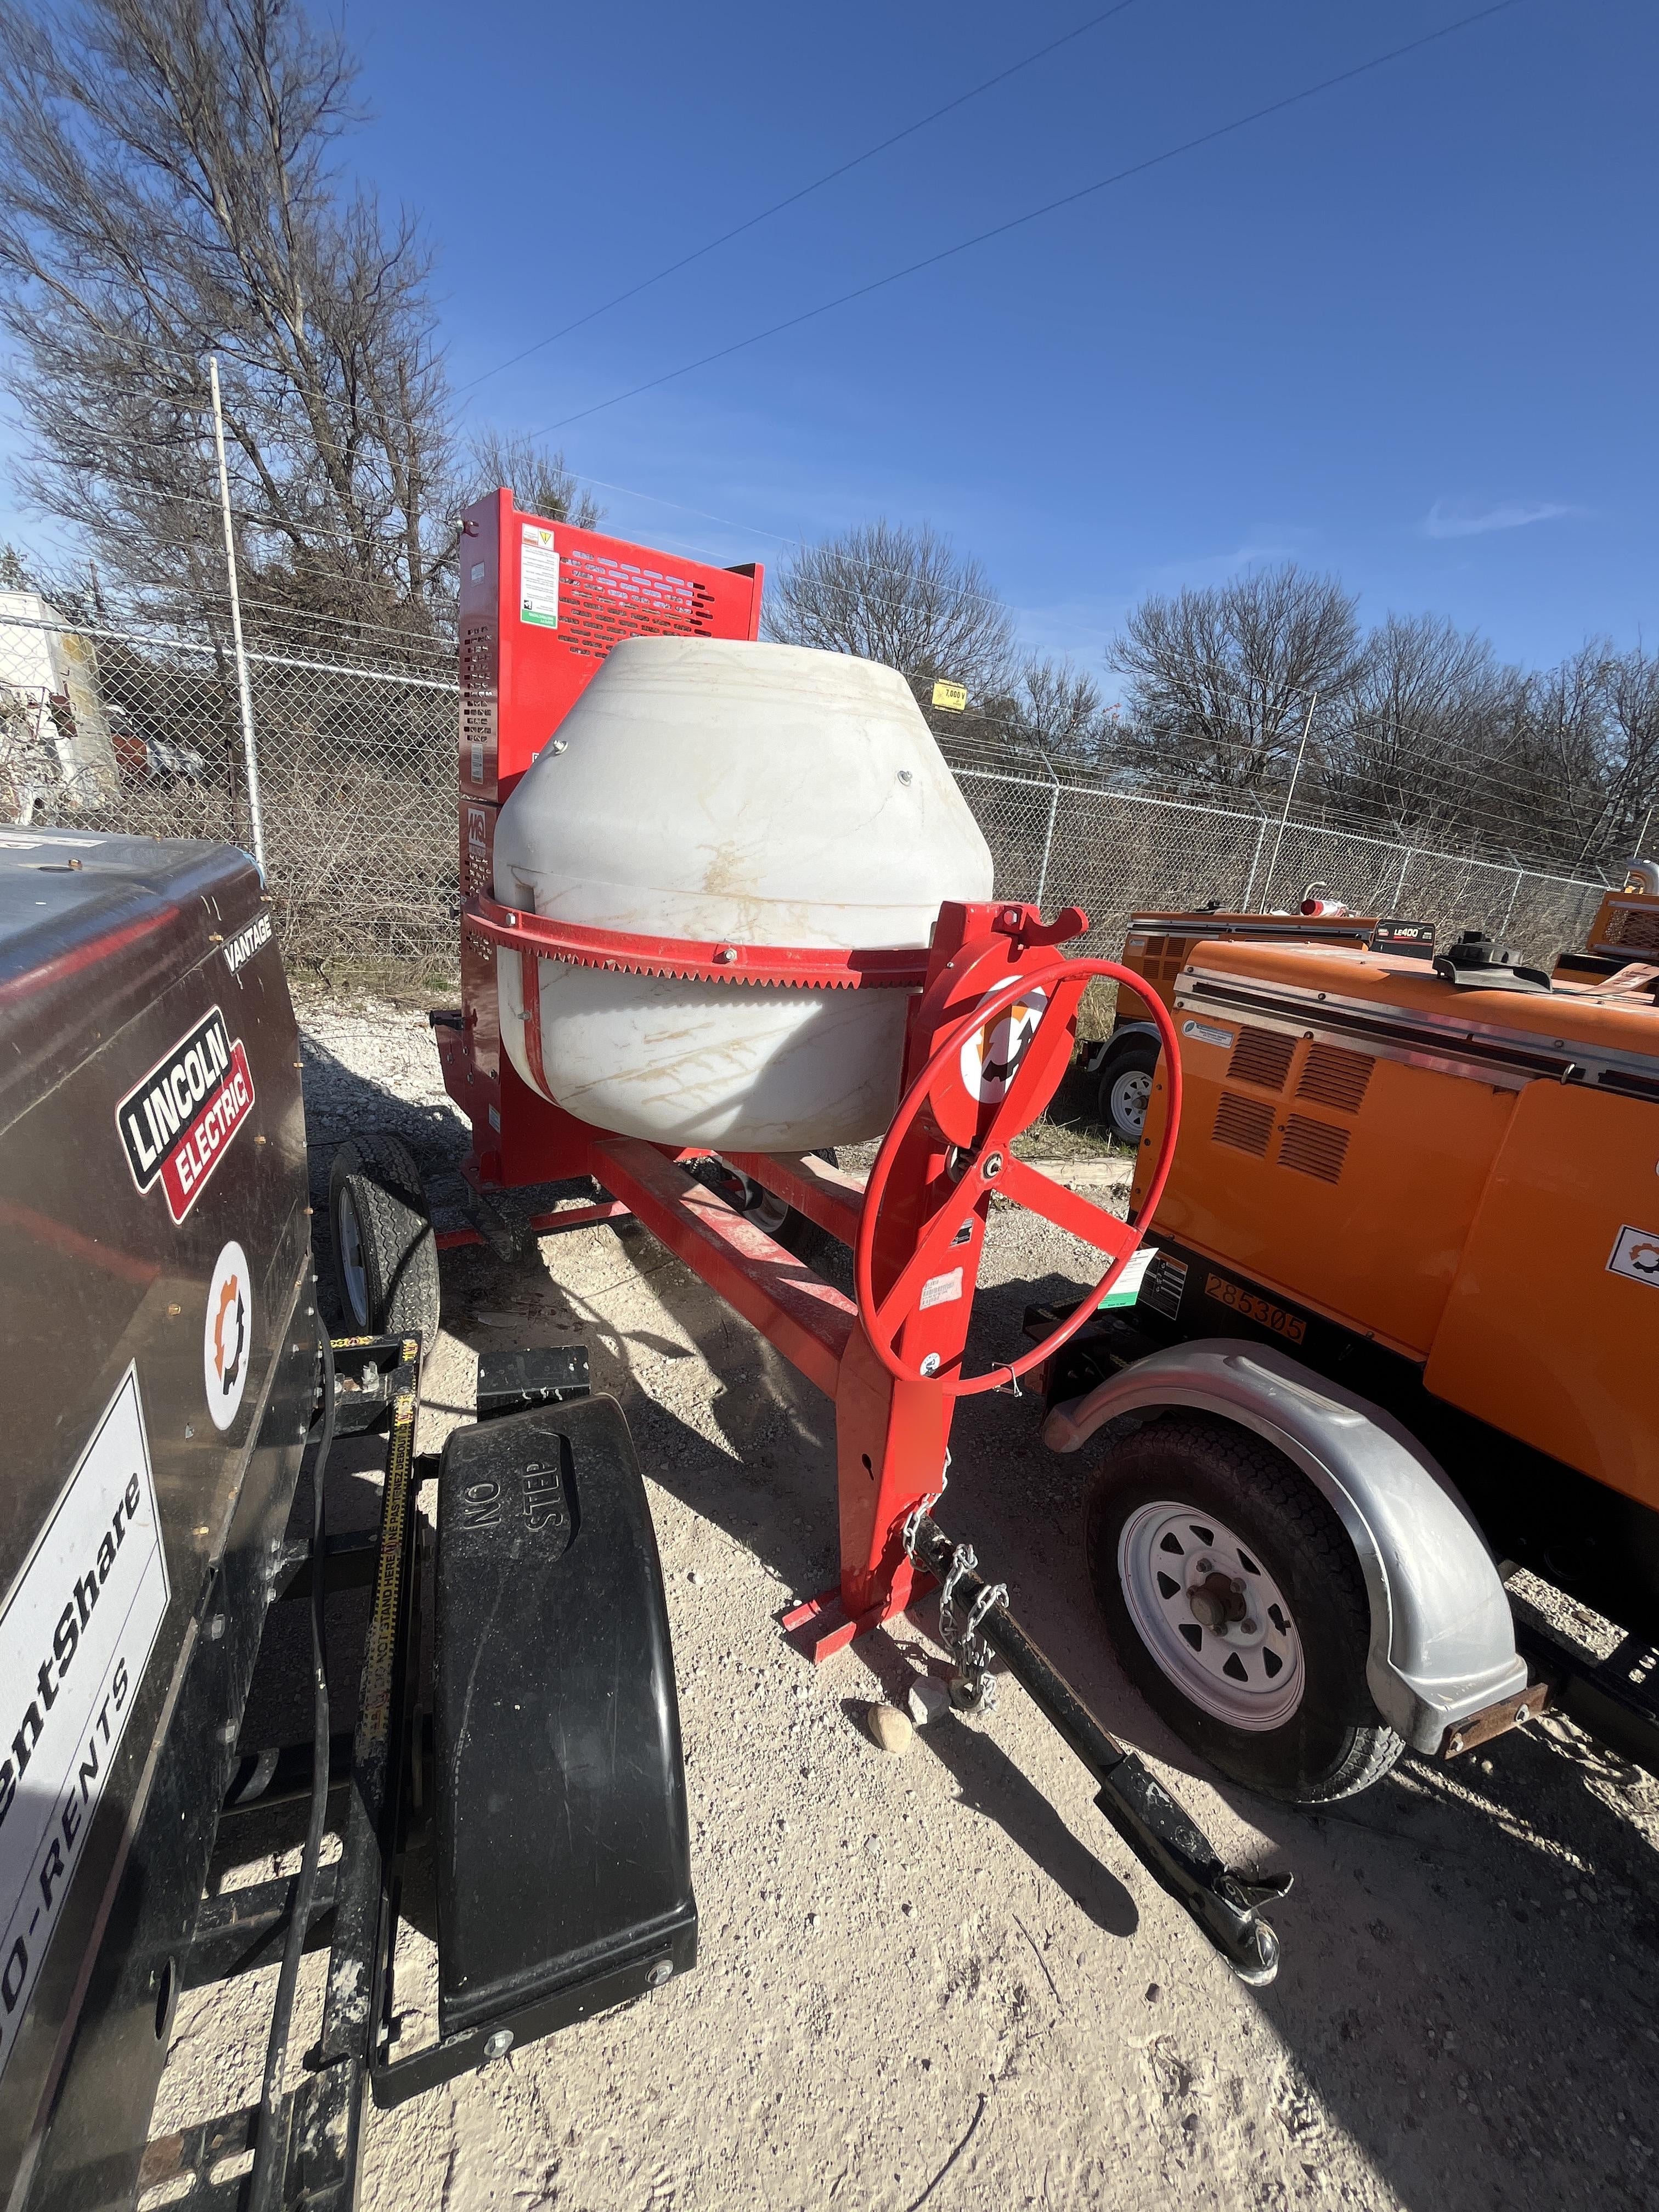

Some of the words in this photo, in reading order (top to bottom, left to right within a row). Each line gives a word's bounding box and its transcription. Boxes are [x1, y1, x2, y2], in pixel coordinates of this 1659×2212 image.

[946, 689, 961, 698] 7,000
[223, 914, 273, 973] VANTAGE
[1393, 928, 1419, 938] LE400
[128, 1022, 229, 1172] LINCOLN
[175, 1071, 248, 1195] ELECTRIC
[1206, 1276, 1304, 1340] 285305
[396, 1436, 407, 1471] DEBOUT
[390, 1504, 400, 1524] PAS
[464, 1482, 501, 1530] NO
[522, 1462, 563, 1532] STEP
[388, 1525, 398, 1541] NE
[383, 1555, 396, 1587] HERE
[379, 1589, 393, 1632] STAND
[376, 1635, 388, 1664] NOT
